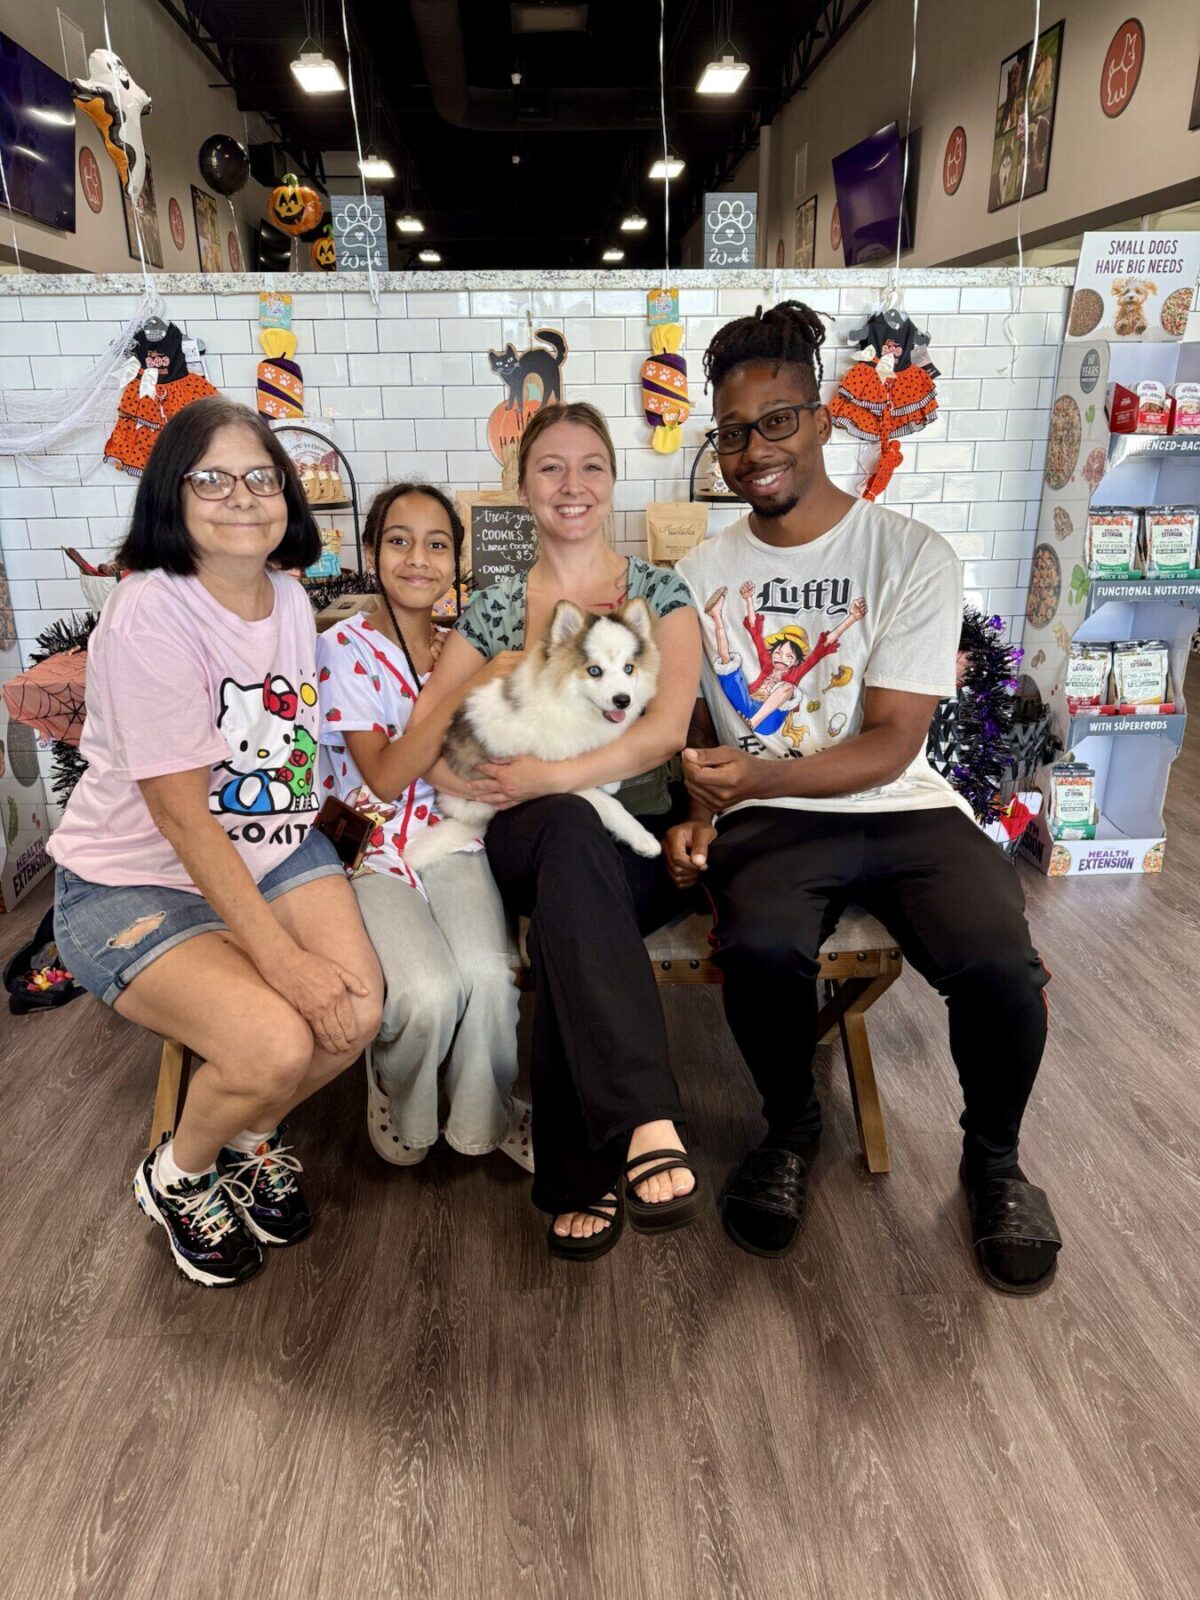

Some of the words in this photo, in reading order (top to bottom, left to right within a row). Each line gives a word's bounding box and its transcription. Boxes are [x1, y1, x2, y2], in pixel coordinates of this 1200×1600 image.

[1109, 240, 1145, 255] SMALL
[1148, 239, 1179, 255] DOGS
[1095, 260, 1124, 274] HAVE
[1126, 259, 1145, 274] BIG
[1147, 259, 1184, 274] NEEDS
[482, 529, 524, 541] COOKIES
[481, 543, 508, 552] LARGE
[516, 551, 533, 561] $5
[482, 564, 516, 574] DONUTS
[755, 577, 850, 615] Luffy
[1097, 586, 1152, 596] FUNCTIONAL
[1154, 585, 1200, 596] NUTRITION
[1090, 722, 1112, 732] WITH
[1113, 720, 1168, 731] SUPERFOODS
[268, 818, 313, 845] KIT
[16, 836, 44, 871] HEALTH
[1088, 850, 1129, 858] HEALTH
[1078, 857, 1135, 871] EXTENSION
[12, 847, 52, 898] EXTENSION
